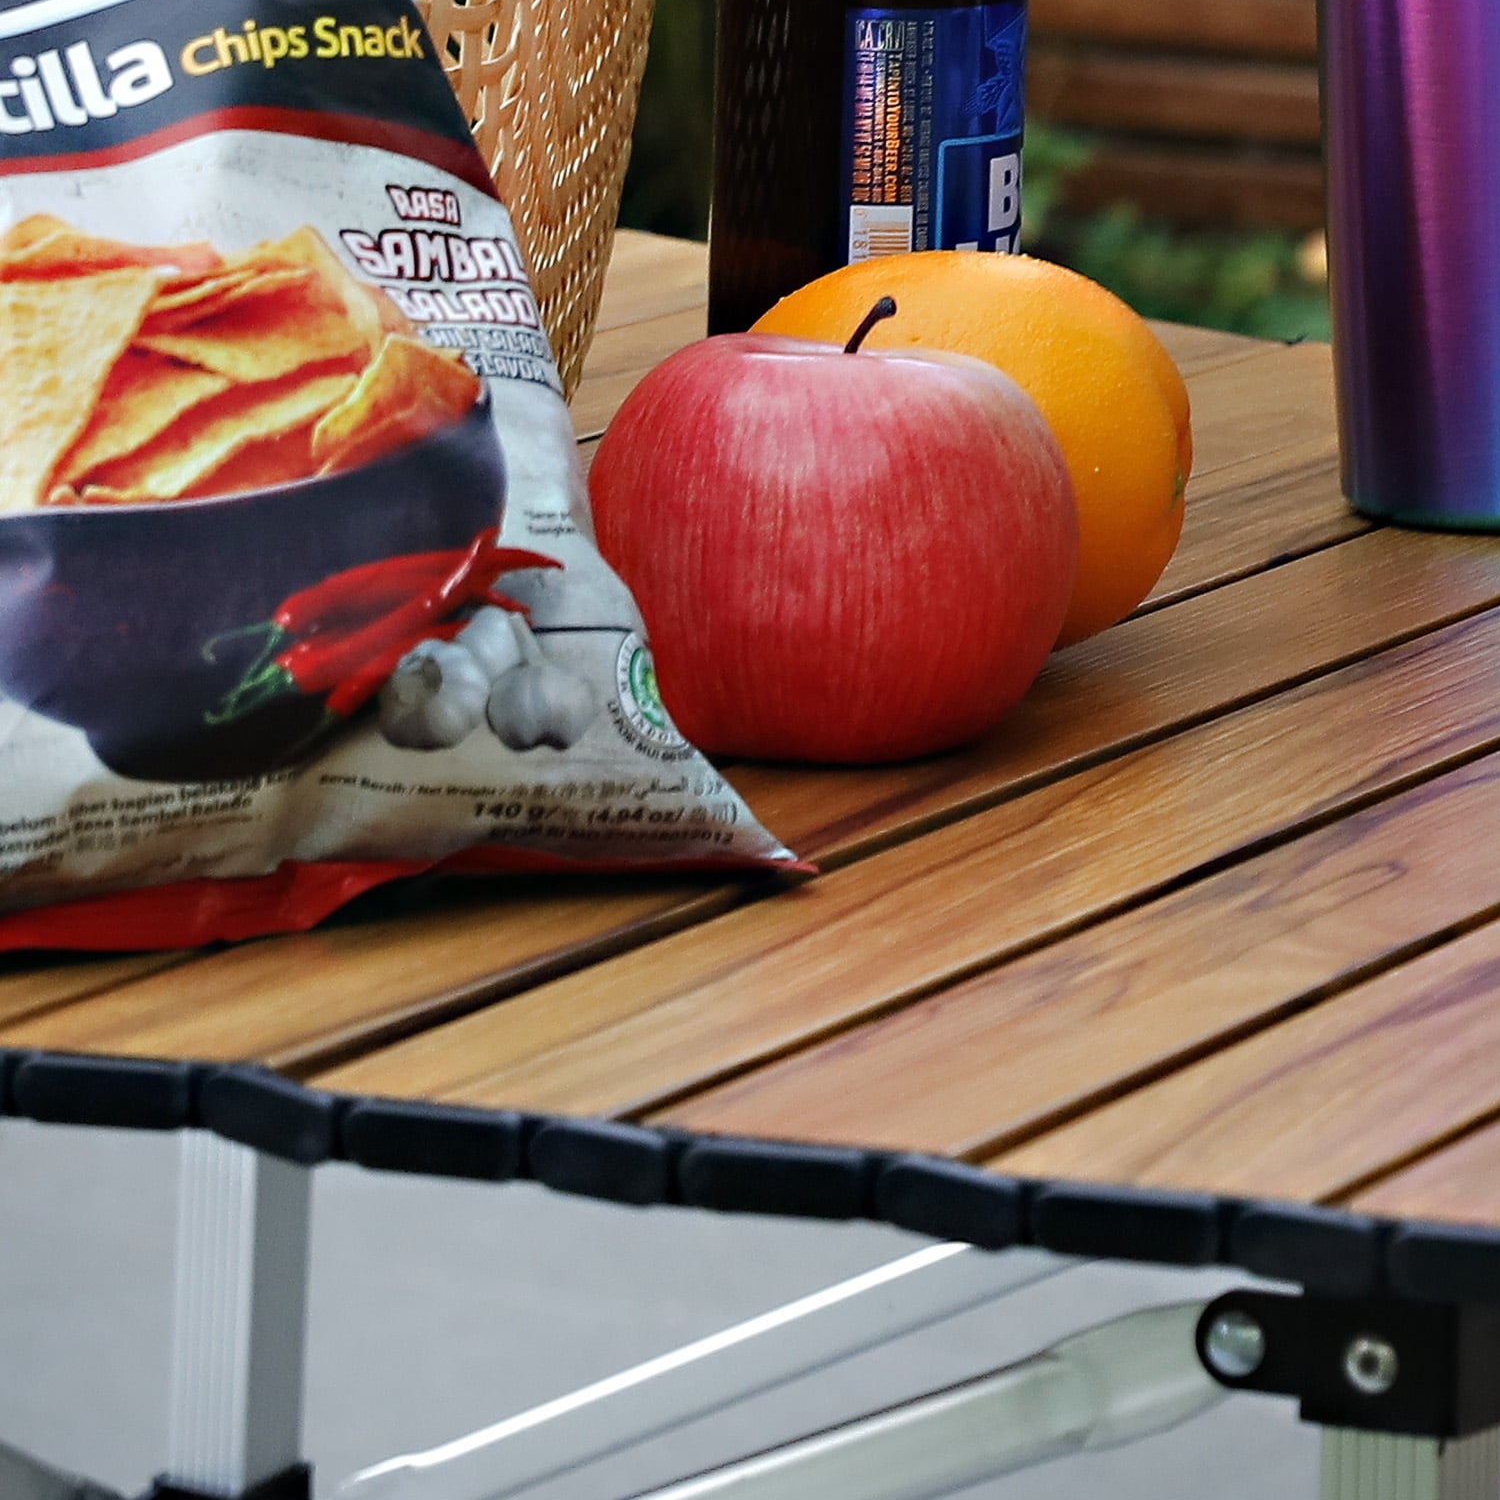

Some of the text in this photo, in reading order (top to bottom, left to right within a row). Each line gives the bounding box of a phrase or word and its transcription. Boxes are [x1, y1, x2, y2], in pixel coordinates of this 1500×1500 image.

[313, 15, 425, 60] Snack
[385, 184, 461, 227] RASA
[340, 229, 529, 284] SAMBAL
